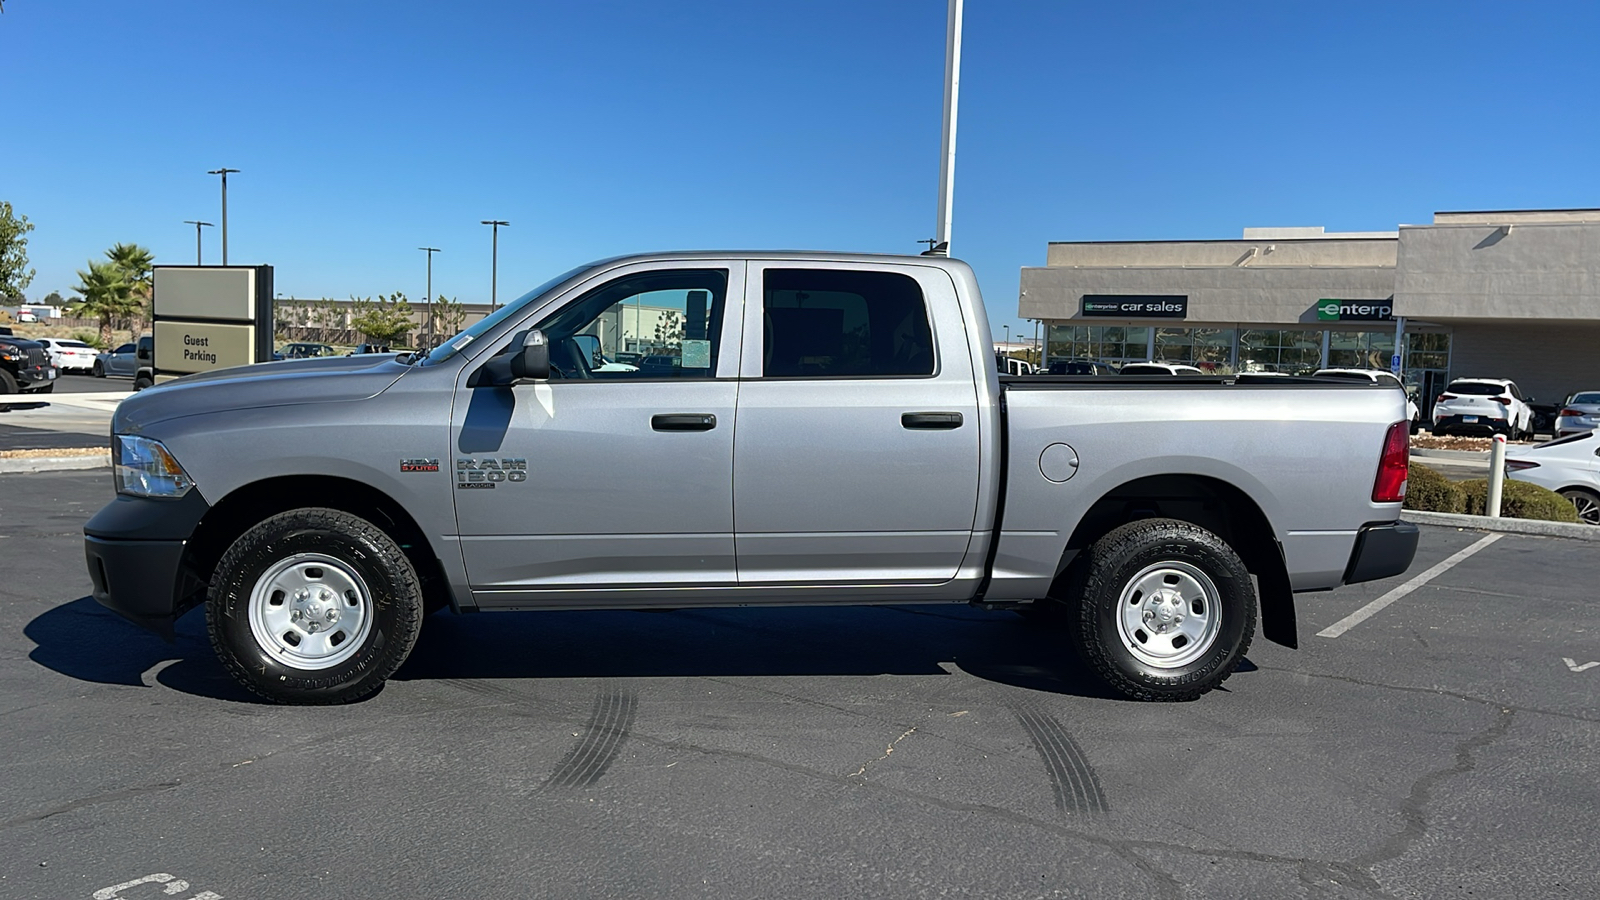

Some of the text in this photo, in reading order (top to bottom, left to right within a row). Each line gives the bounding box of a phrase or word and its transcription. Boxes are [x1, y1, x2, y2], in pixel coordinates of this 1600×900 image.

[1121, 303, 1143, 312] car
[1146, 301, 1182, 312] sales
[1318, 304, 1391, 318] enterp
[184, 334, 208, 346] Guest
[184, 349, 216, 364] Parking
[457, 458, 527, 470] RAM
[457, 470, 527, 482] 1500
